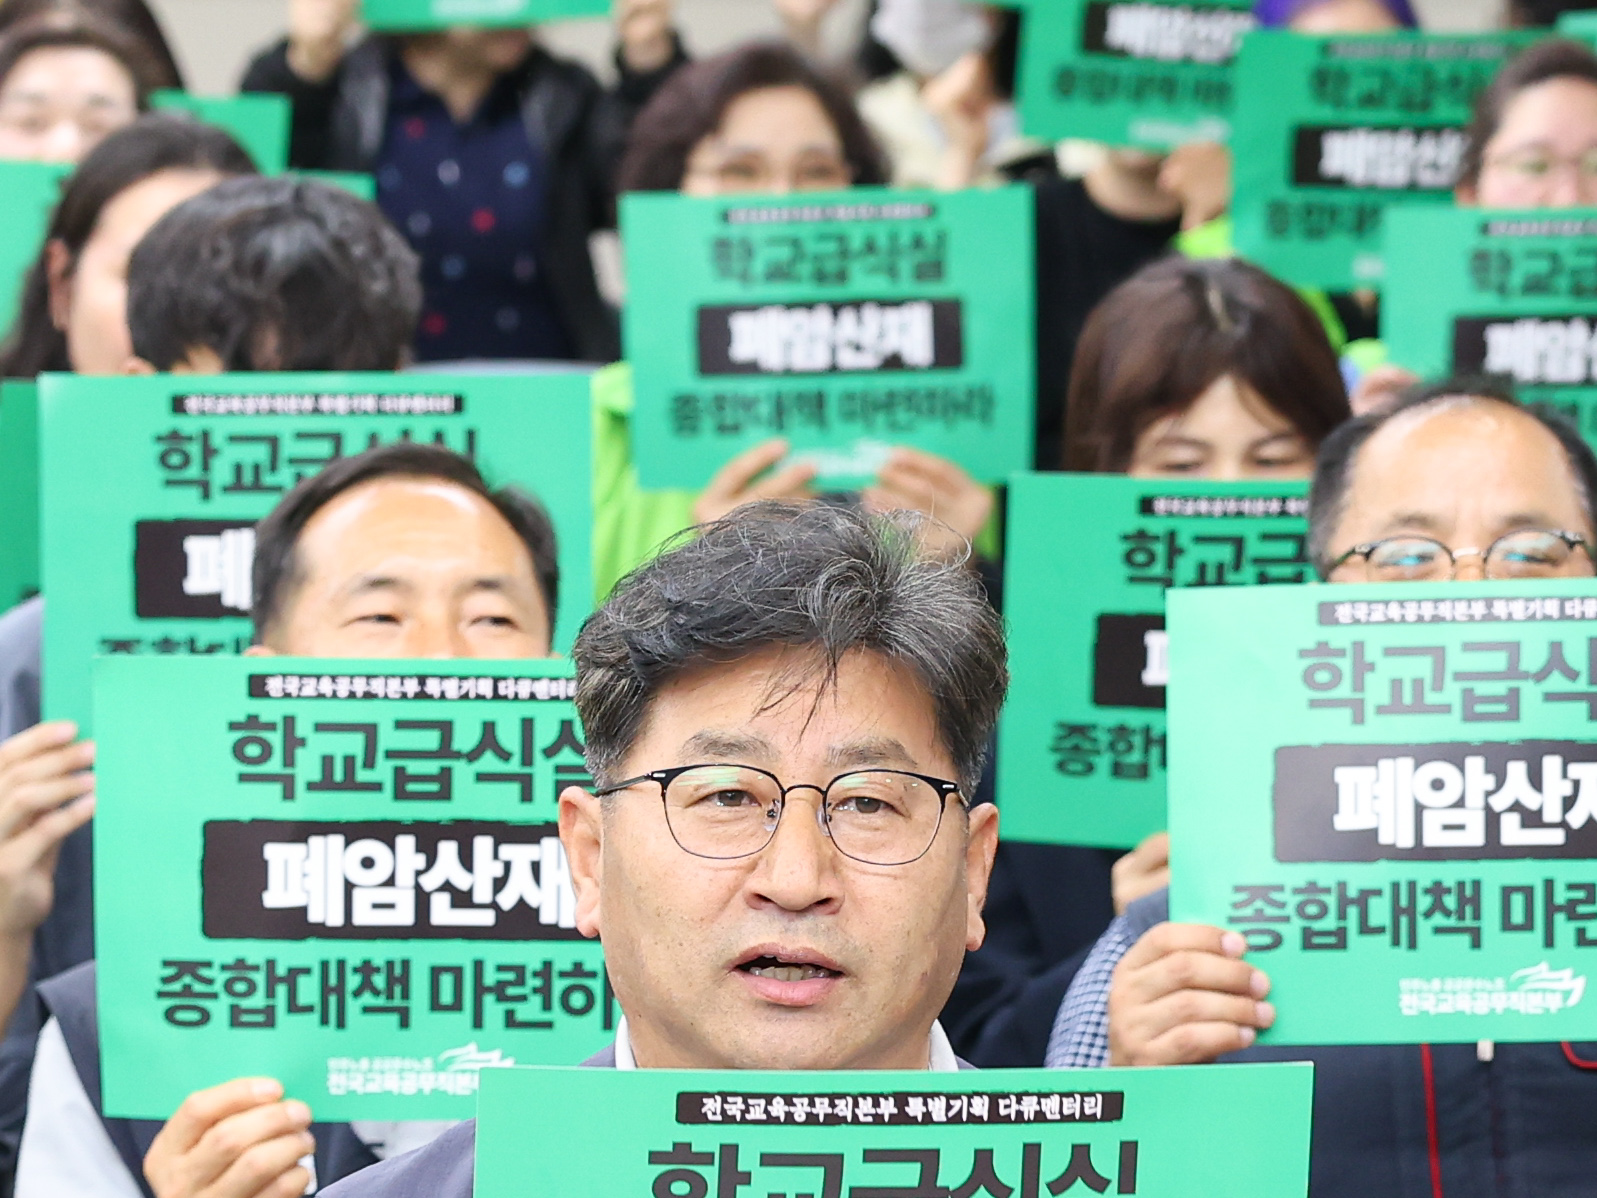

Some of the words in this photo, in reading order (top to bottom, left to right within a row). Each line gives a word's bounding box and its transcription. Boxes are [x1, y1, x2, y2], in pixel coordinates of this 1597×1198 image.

[1051, 722, 1166, 781] 종합
[262, 834, 578, 928] 폐암산재
[1227, 879, 1481, 951] 종합대책
[157, 957, 410, 1030] 종합대책
[701, 1095, 898, 1123] 전국교육공무직본부
[904, 1094, 990, 1122] 특별기획
[998, 1093, 1104, 1121] 다큐멘터리
